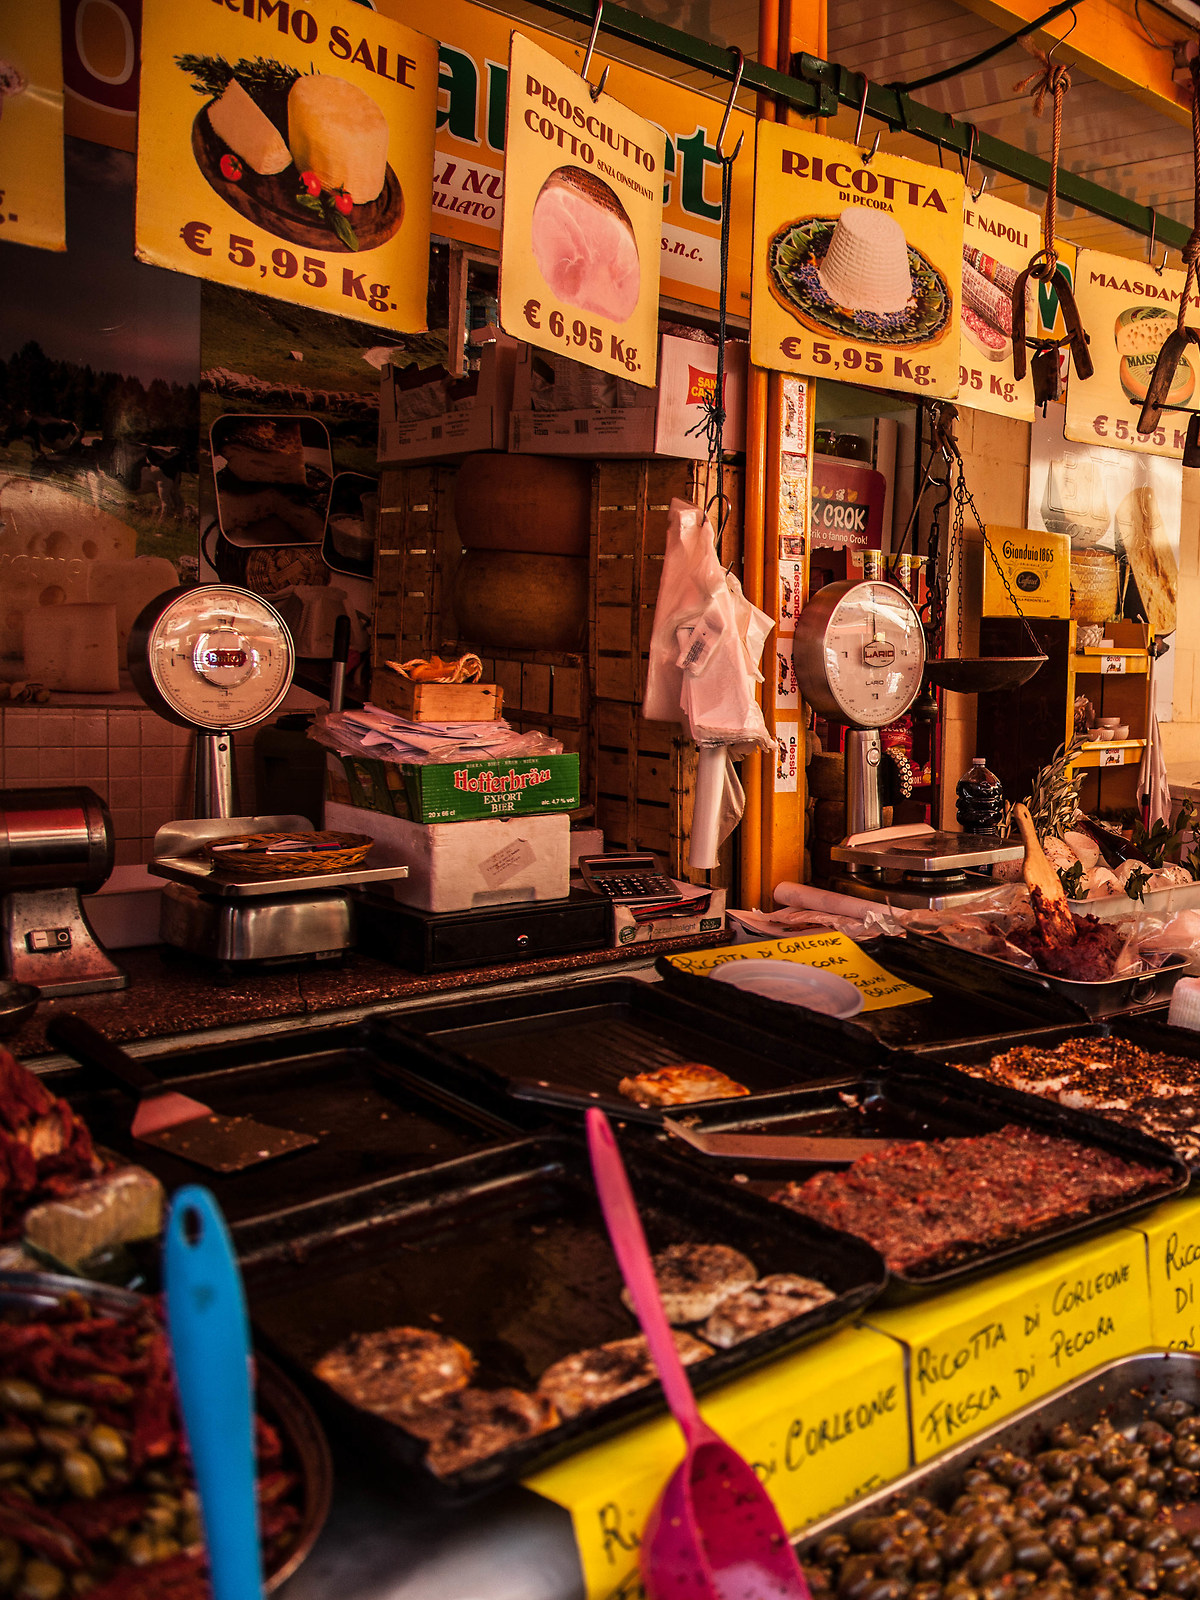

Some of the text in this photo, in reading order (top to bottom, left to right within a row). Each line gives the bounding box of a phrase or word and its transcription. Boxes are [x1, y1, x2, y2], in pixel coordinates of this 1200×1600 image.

[212, 0, 417, 90] IMO SALE
[525, 74, 656, 172] PROSCIUTTO
[523, 109, 595, 164] COTTO
[596, 158, 616, 177] SENZA
[781, 149, 948, 214] RICOTTA
[838, 190, 894, 214] DI PECORA
[978, 216, 1028, 249] NAPOLI
[179, 221, 398, 313] € 5,95 Kg.
[523, 299, 641, 372] € 6,95 Kg.
[779, 336, 936, 386] € 5,95 Kg.
[990, 373, 1018, 403] Kg.
[1092, 414, 1108, 438] €
[823, 503, 866, 532] CROK
[828, 533, 848, 543] fanno
[849, 534, 868, 546] Crok!
[1002, 540, 1054, 563] Gianduia 1865
[453, 768, 551, 793] Hofferbräu
[483, 792, 523, 804] EXPORT
[491, 803, 515, 812] BIER
[776, 937, 842, 954] CORLEONE
[1052, 1263, 1130, 1317] CORLEONE
[919, 1385, 1001, 1445] FRESCA
[1048, 1316, 1115, 1367] PECORA
[783, 1384, 898, 1472] CORLEONE
